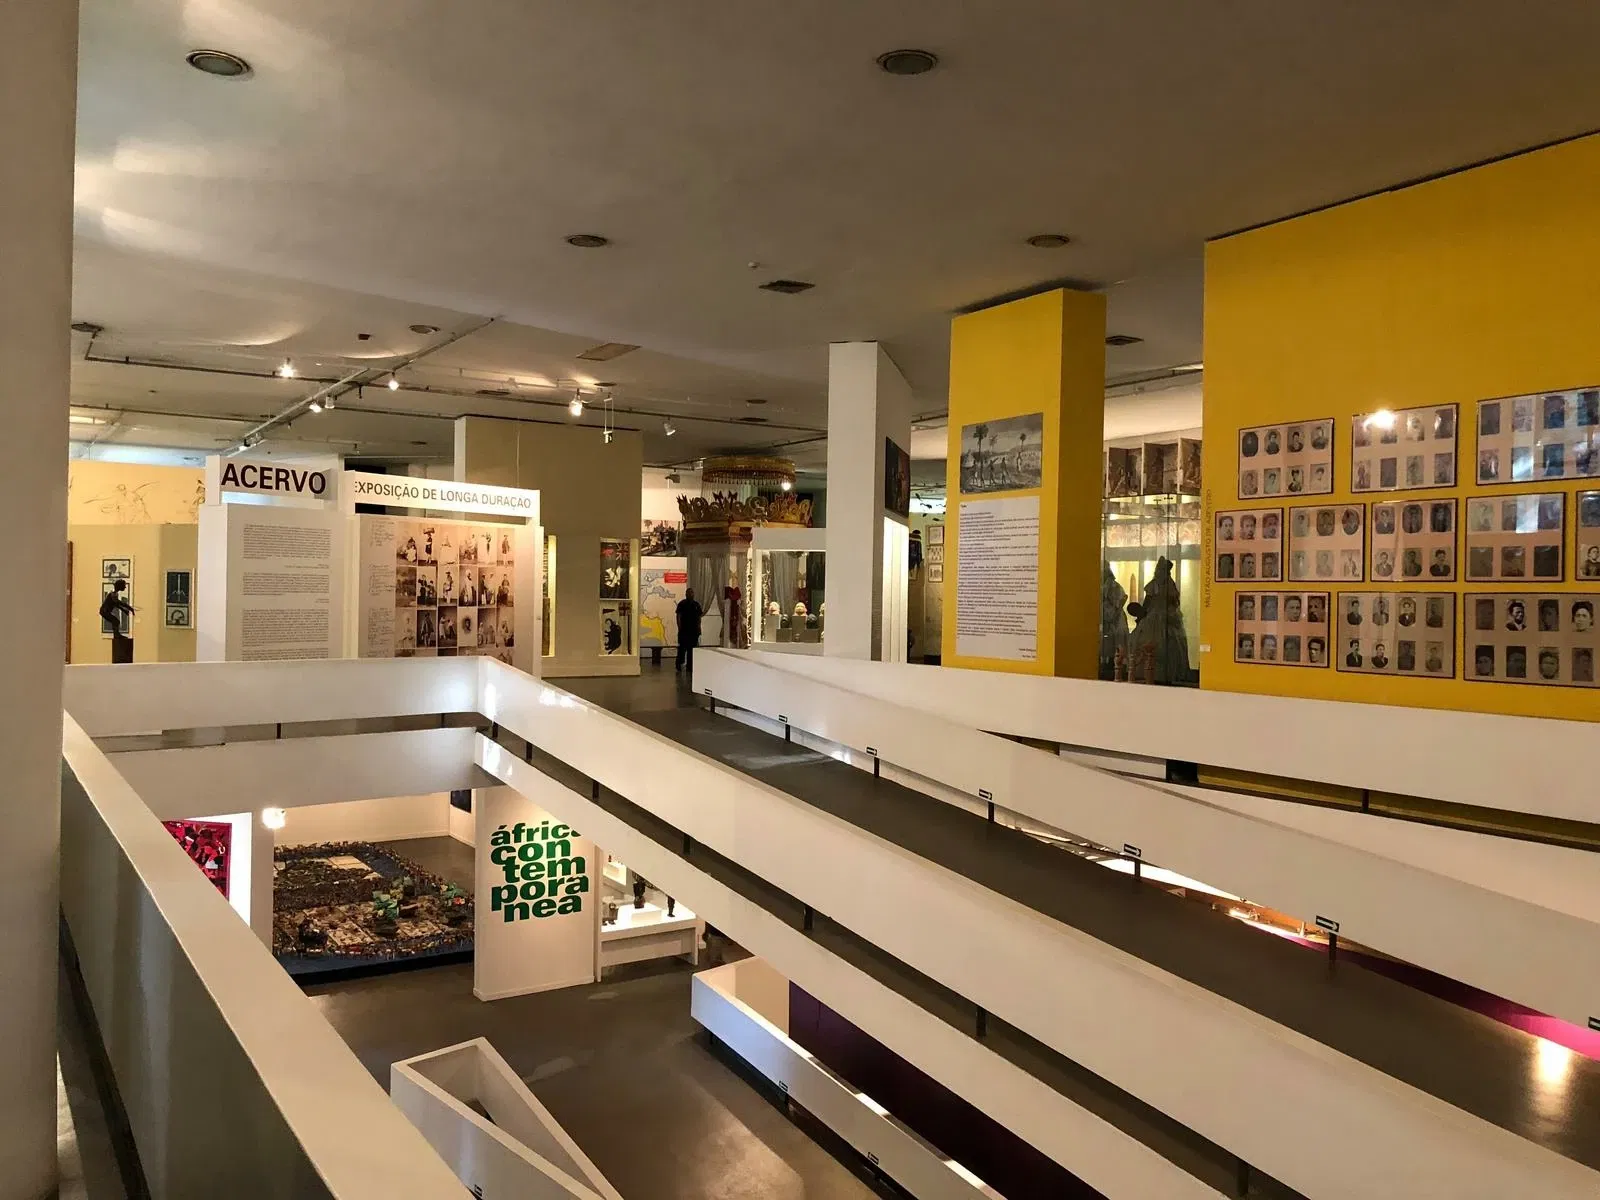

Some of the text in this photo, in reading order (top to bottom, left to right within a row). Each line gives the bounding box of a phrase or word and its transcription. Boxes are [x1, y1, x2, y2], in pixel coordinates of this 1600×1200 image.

[221, 463, 326, 494] ACERVO
[422, 487, 437, 499] DE
[440, 489, 479, 503] LONGA
[490, 839, 571, 865] con
[502, 856, 586, 883] tem
[491, 874, 589, 911] pora
[504, 895, 582, 923] nea
